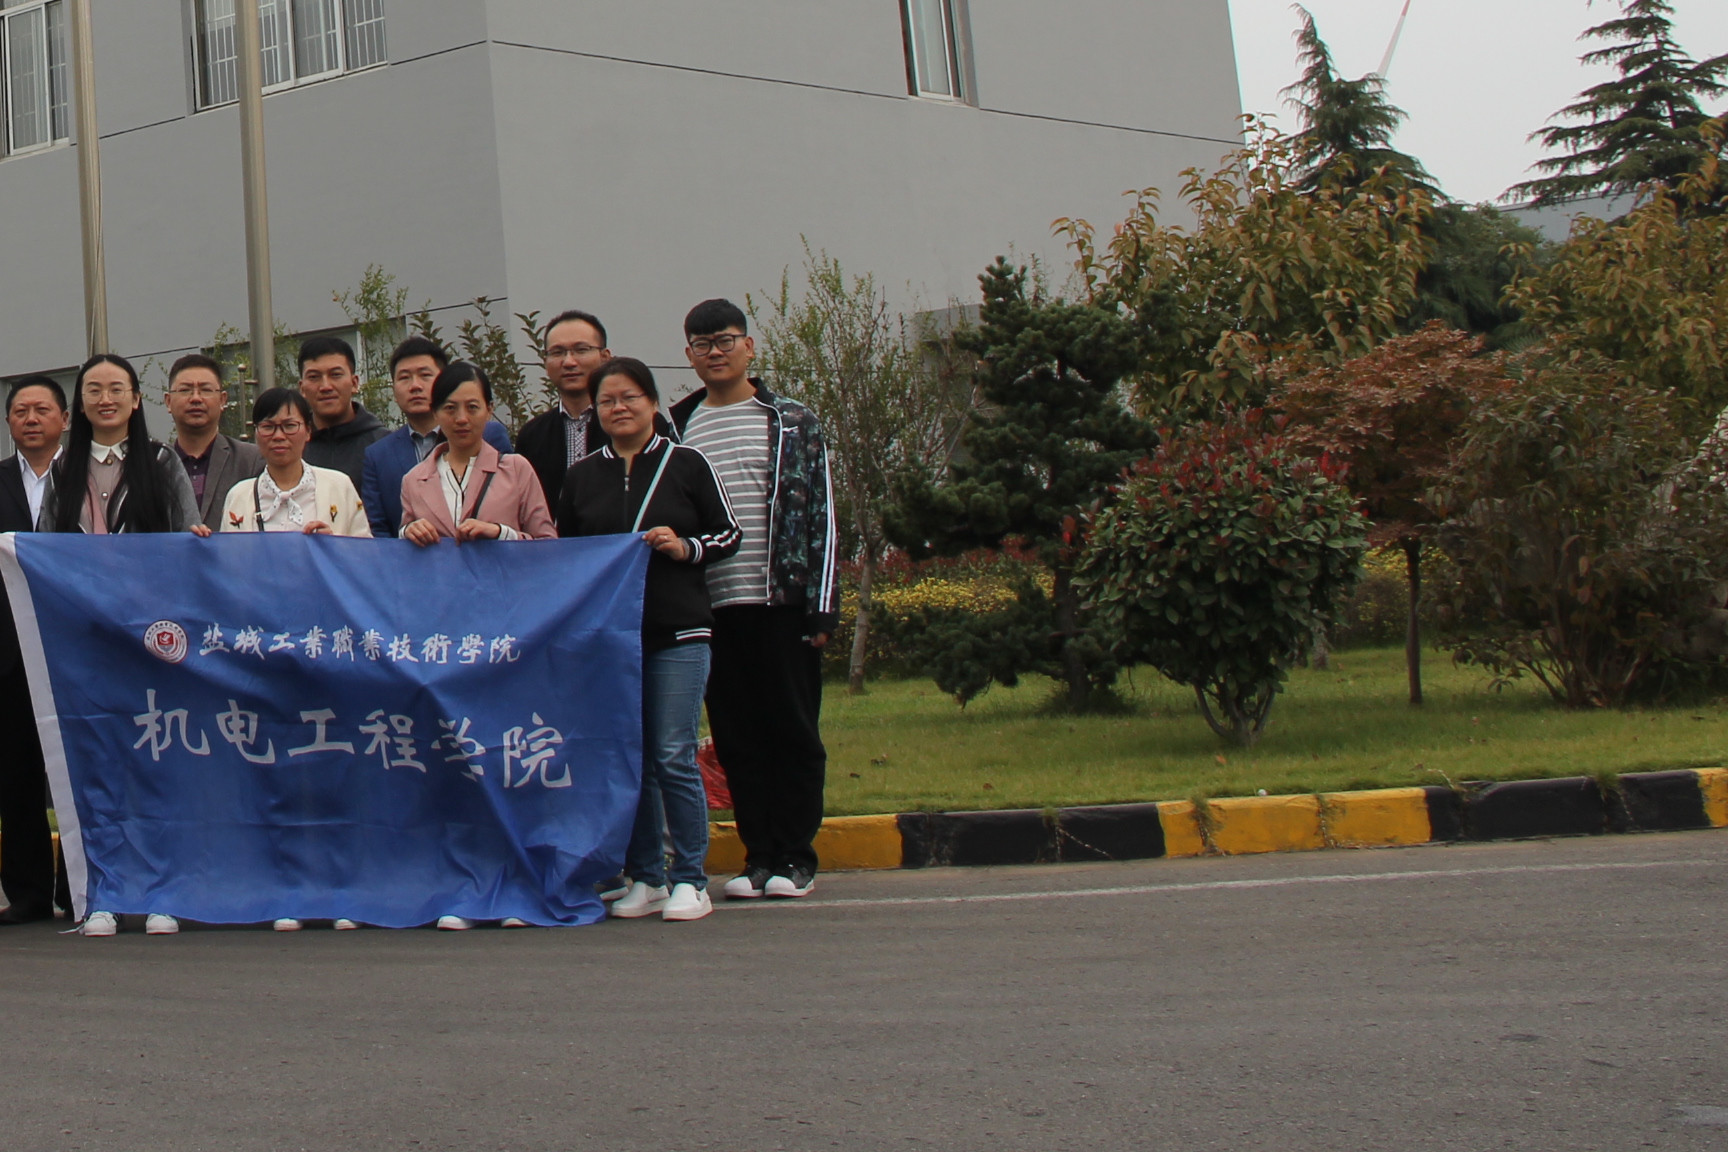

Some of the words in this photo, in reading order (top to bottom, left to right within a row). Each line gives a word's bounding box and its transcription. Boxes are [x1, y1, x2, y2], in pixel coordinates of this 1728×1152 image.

[132, 688, 572, 789] 机电工程学院
